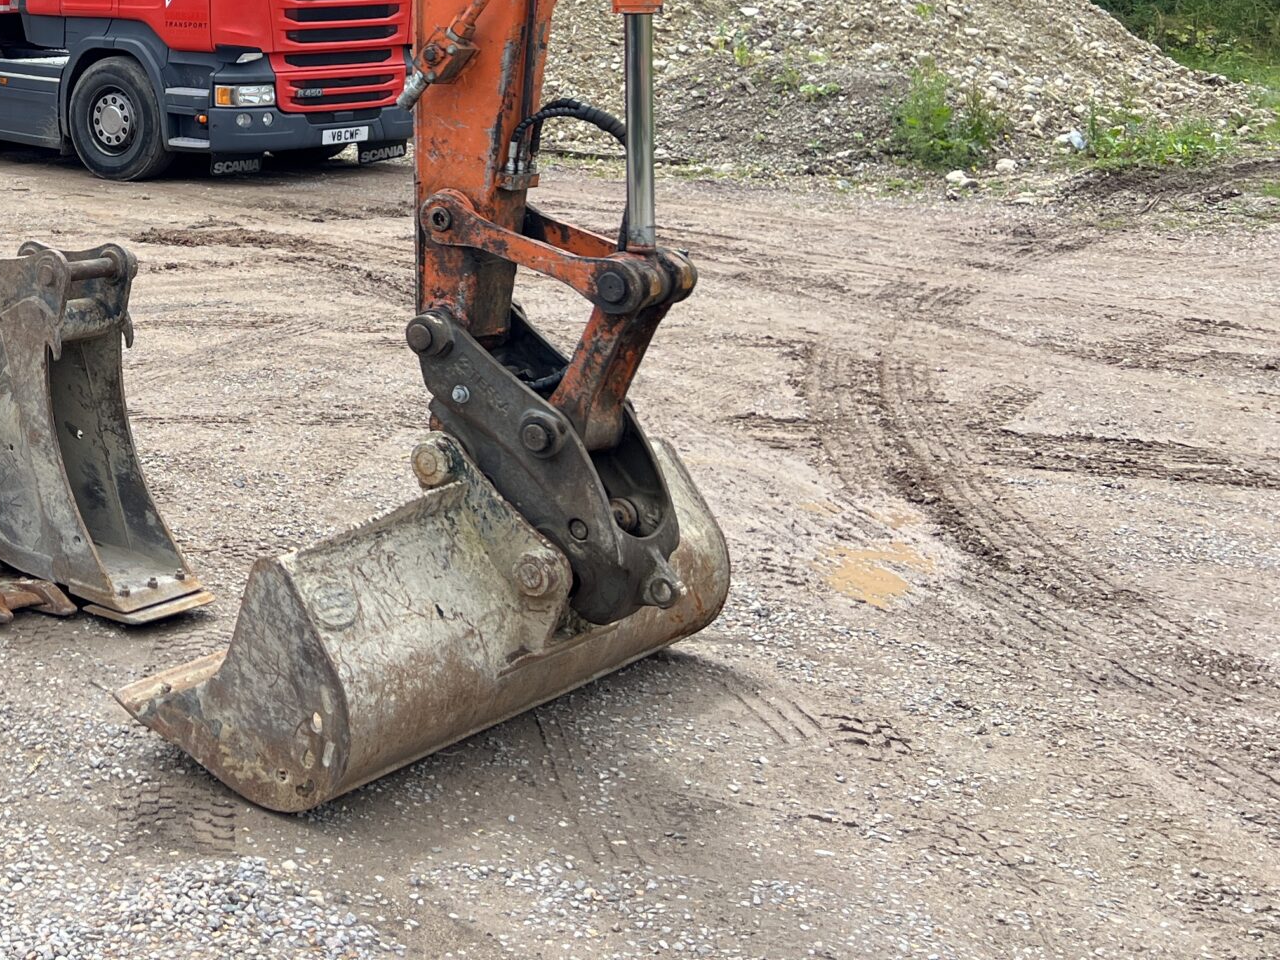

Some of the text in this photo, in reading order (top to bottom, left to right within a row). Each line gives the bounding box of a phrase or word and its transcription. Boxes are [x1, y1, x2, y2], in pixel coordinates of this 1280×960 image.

[165, 21, 208, 29] TRANSPORT
[297, 88, 322, 98] R 450
[331, 128, 360, 142] V8 CWF
[361, 144, 404, 163] SCANIA
[213, 159, 260, 174] SCANIA
